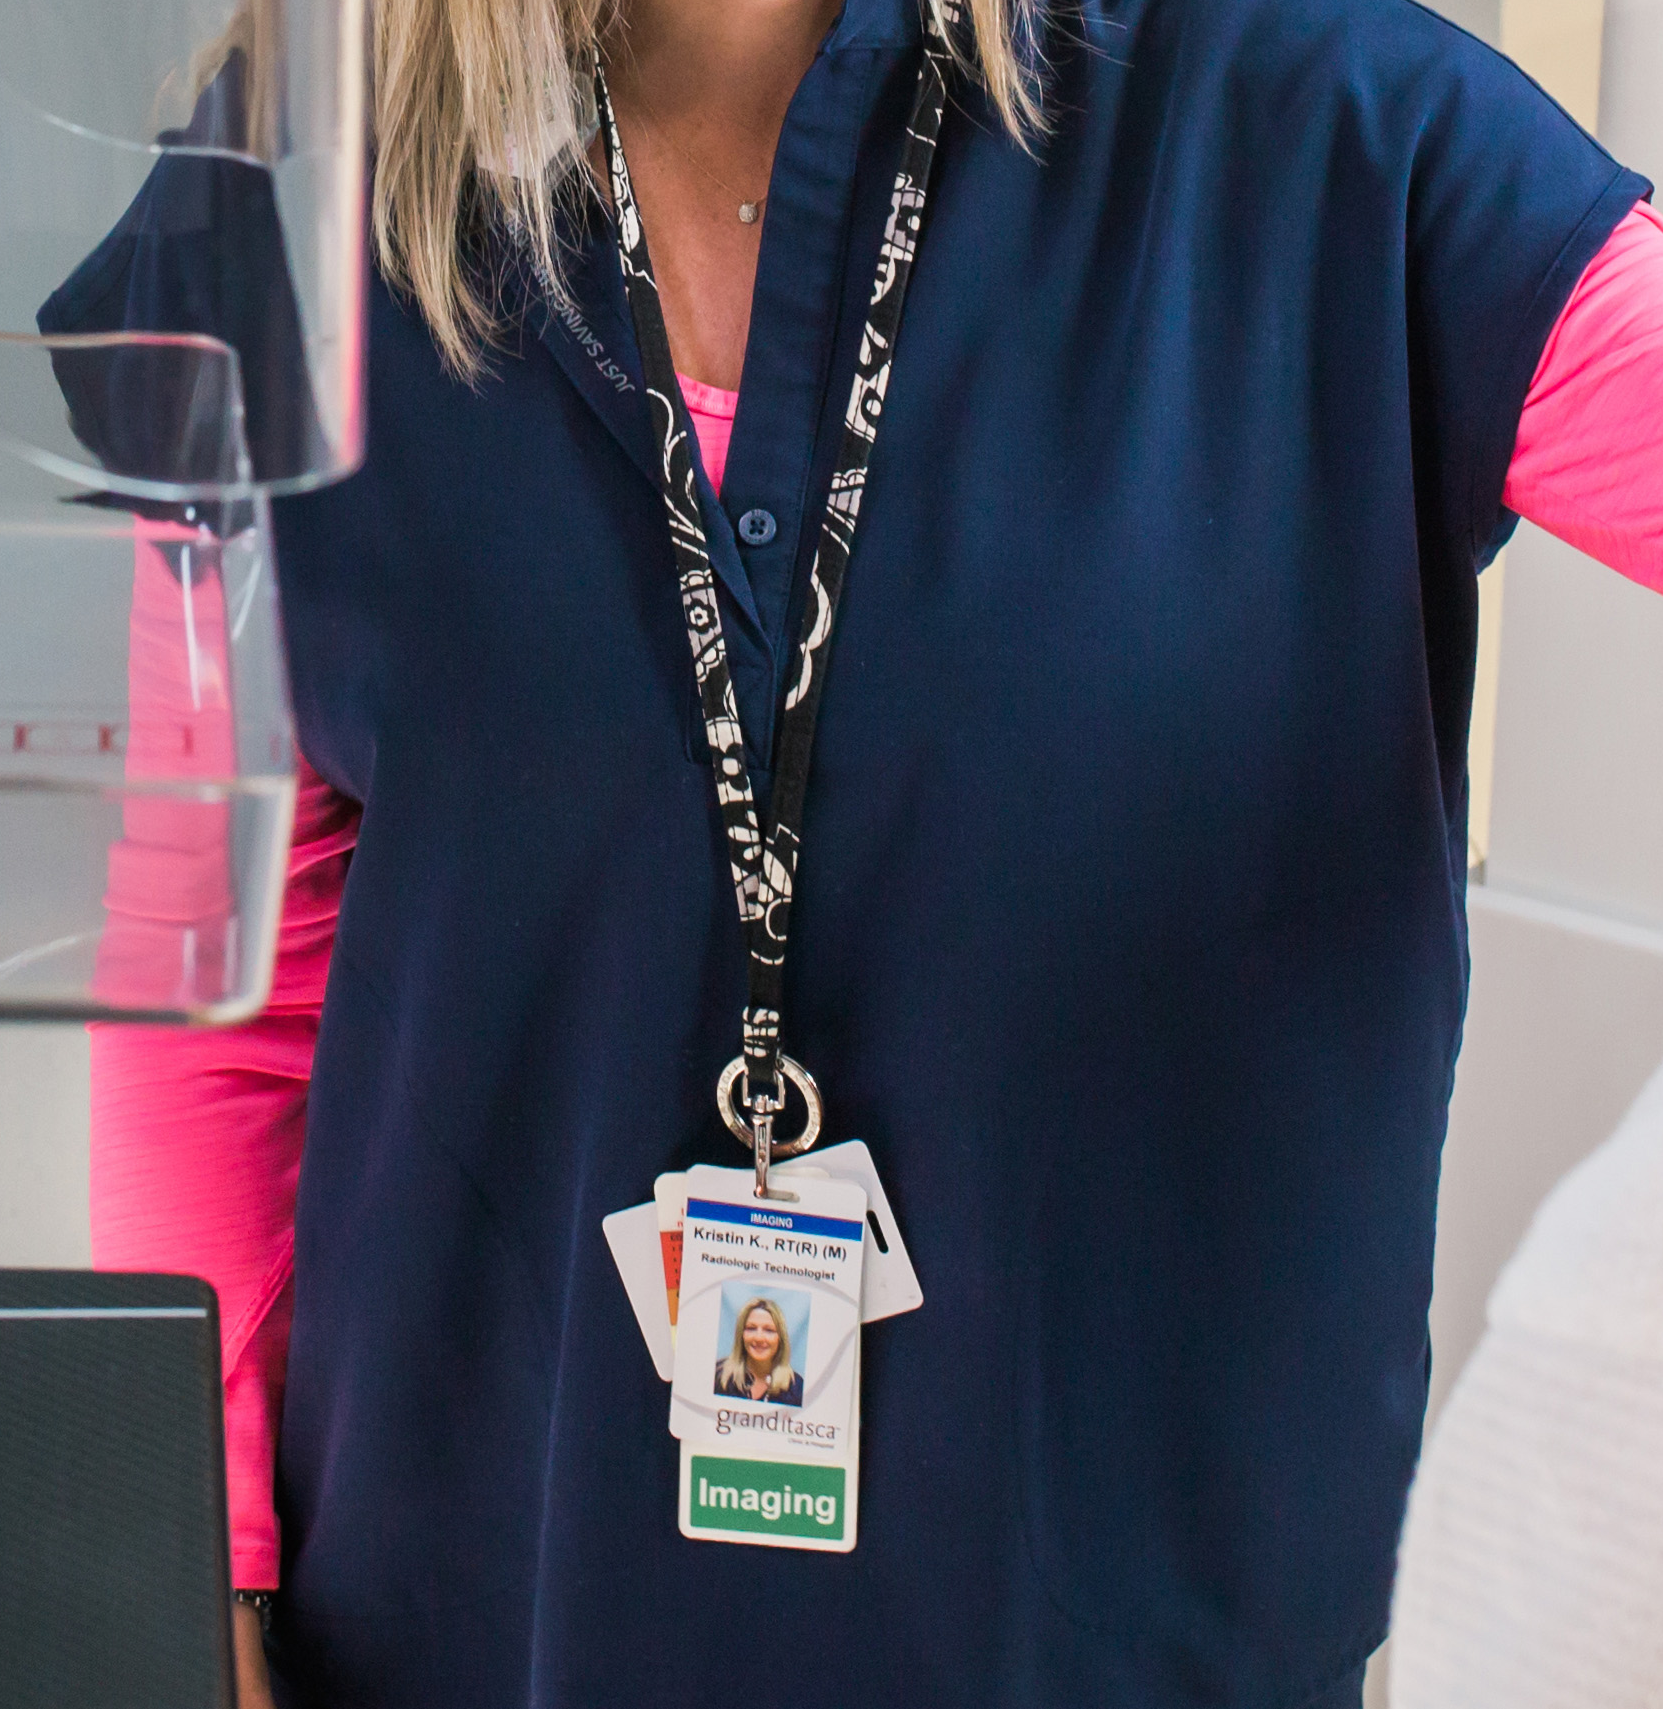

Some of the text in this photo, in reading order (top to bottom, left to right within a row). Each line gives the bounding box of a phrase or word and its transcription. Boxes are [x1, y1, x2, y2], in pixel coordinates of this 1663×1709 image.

[553, 296, 605, 357] SAVING
[595, 358, 636, 393] JUST
[750, 1212, 793, 1229] IMAGING
[693, 1226, 848, 1263] Kristin K., RT(R) (M)
[701, 1252, 836, 1282] Radiologic Technologist
[699, 1477, 837, 1525] Imaging
